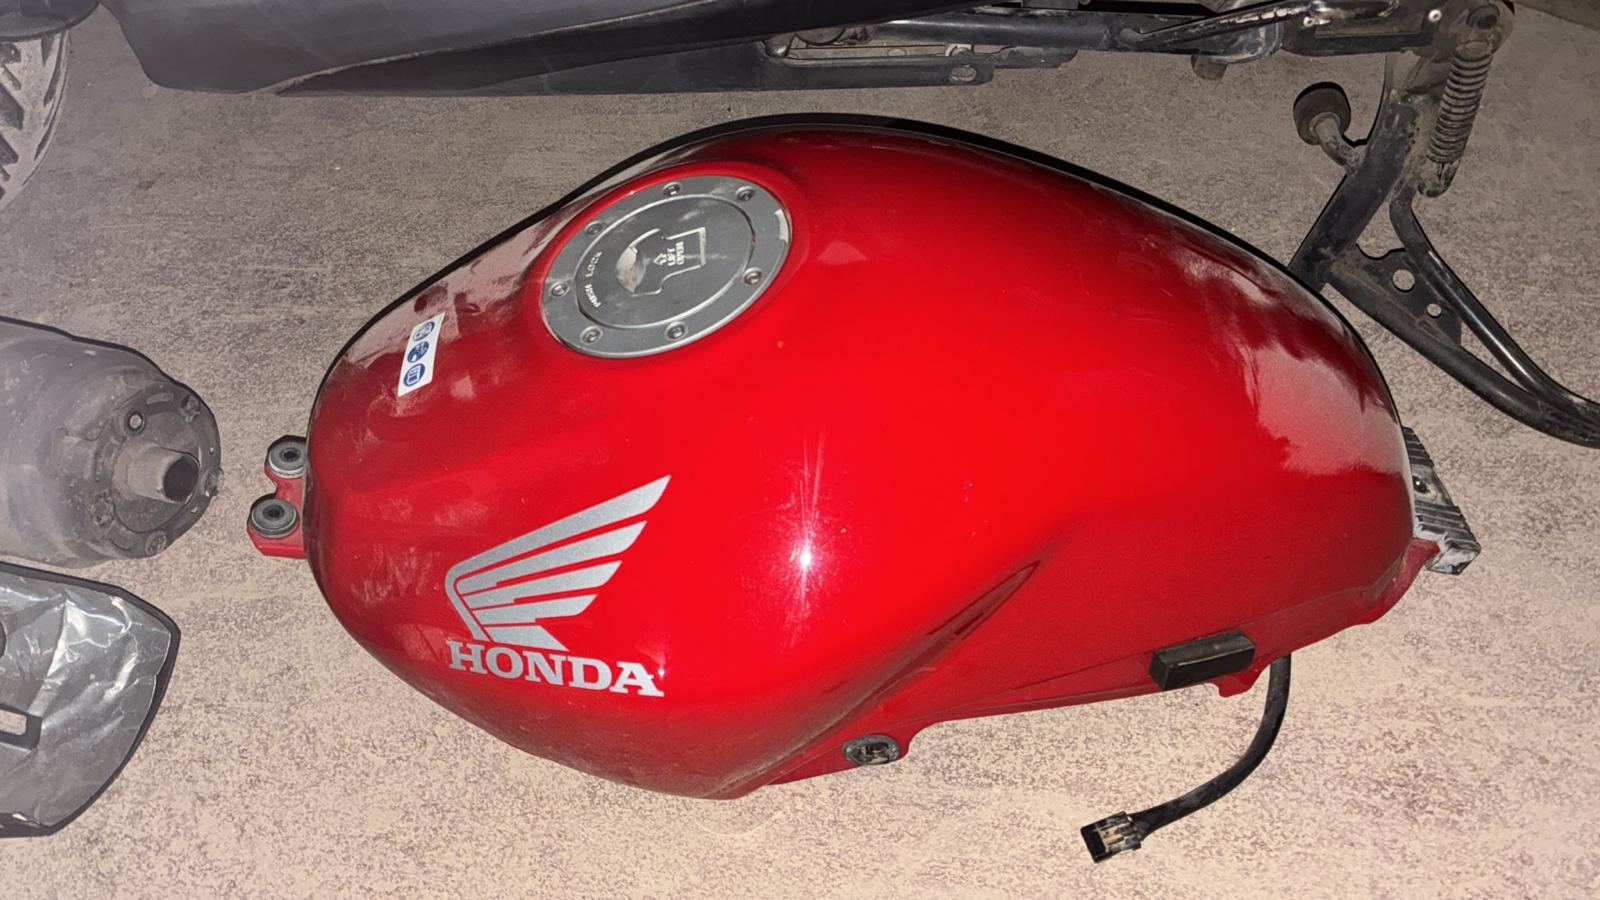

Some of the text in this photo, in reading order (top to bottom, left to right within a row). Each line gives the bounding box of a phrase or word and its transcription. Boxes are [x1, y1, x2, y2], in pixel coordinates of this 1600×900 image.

[667, 247, 676, 267] LIFT
[675, 241, 685, 266] OPEN
[584, 251, 602, 308] PUSH LOCK
[446, 639, 665, 698] HONDA
